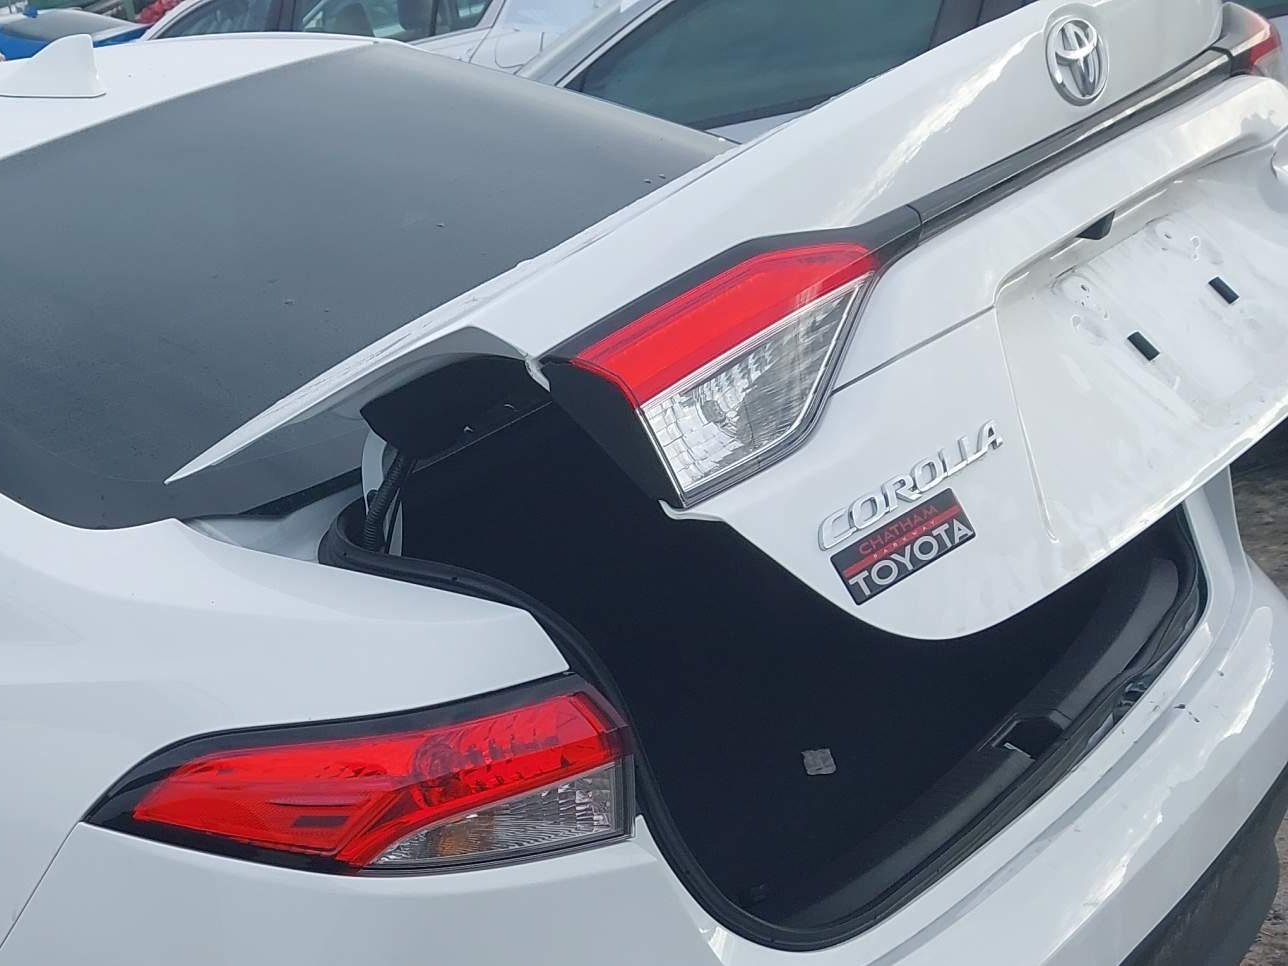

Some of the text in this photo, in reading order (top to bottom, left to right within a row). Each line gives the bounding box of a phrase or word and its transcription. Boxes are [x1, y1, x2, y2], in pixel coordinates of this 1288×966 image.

[818, 419, 1004, 551] COROLLA
[848, 518, 973, 597] TOYOTA
[859, 504, 940, 555] CHATHAM
